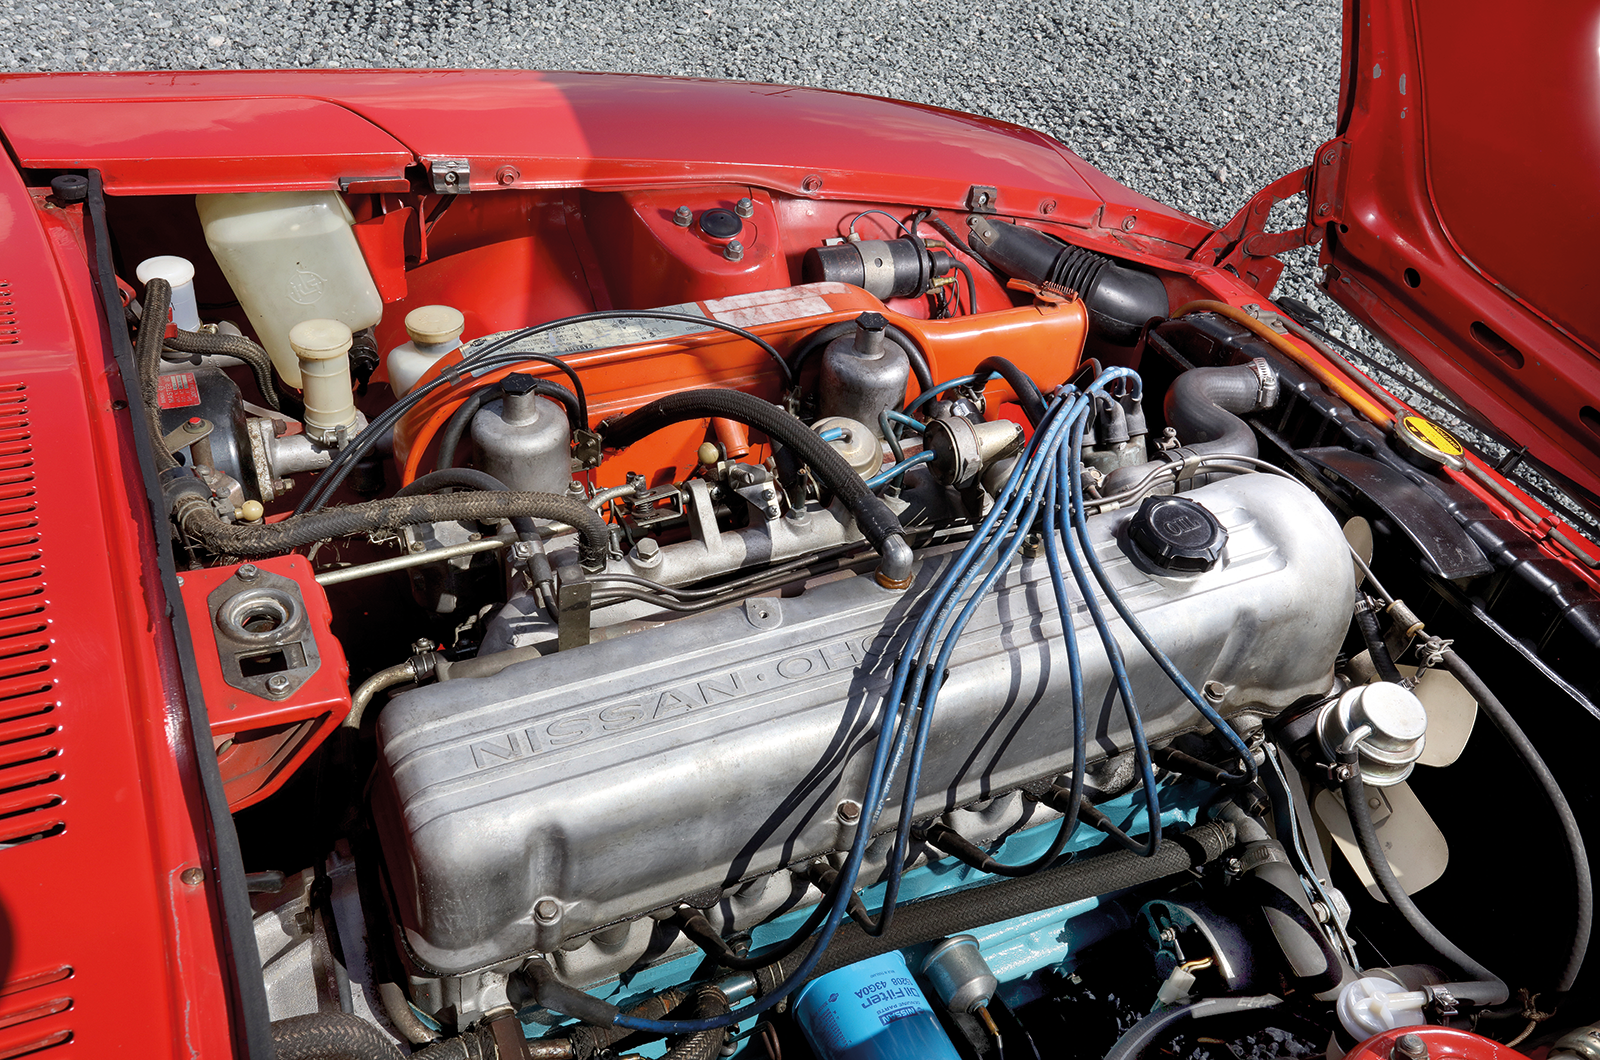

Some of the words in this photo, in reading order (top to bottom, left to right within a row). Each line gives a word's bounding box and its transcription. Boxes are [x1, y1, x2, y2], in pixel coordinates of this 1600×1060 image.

[1163, 512, 1190, 536] OIL
[902, 717, 912, 738] NGK
[893, 742, 906, 767] SPARK
[861, 988, 905, 1009] Filter
[881, 1006, 917, 1025] NISSAN
